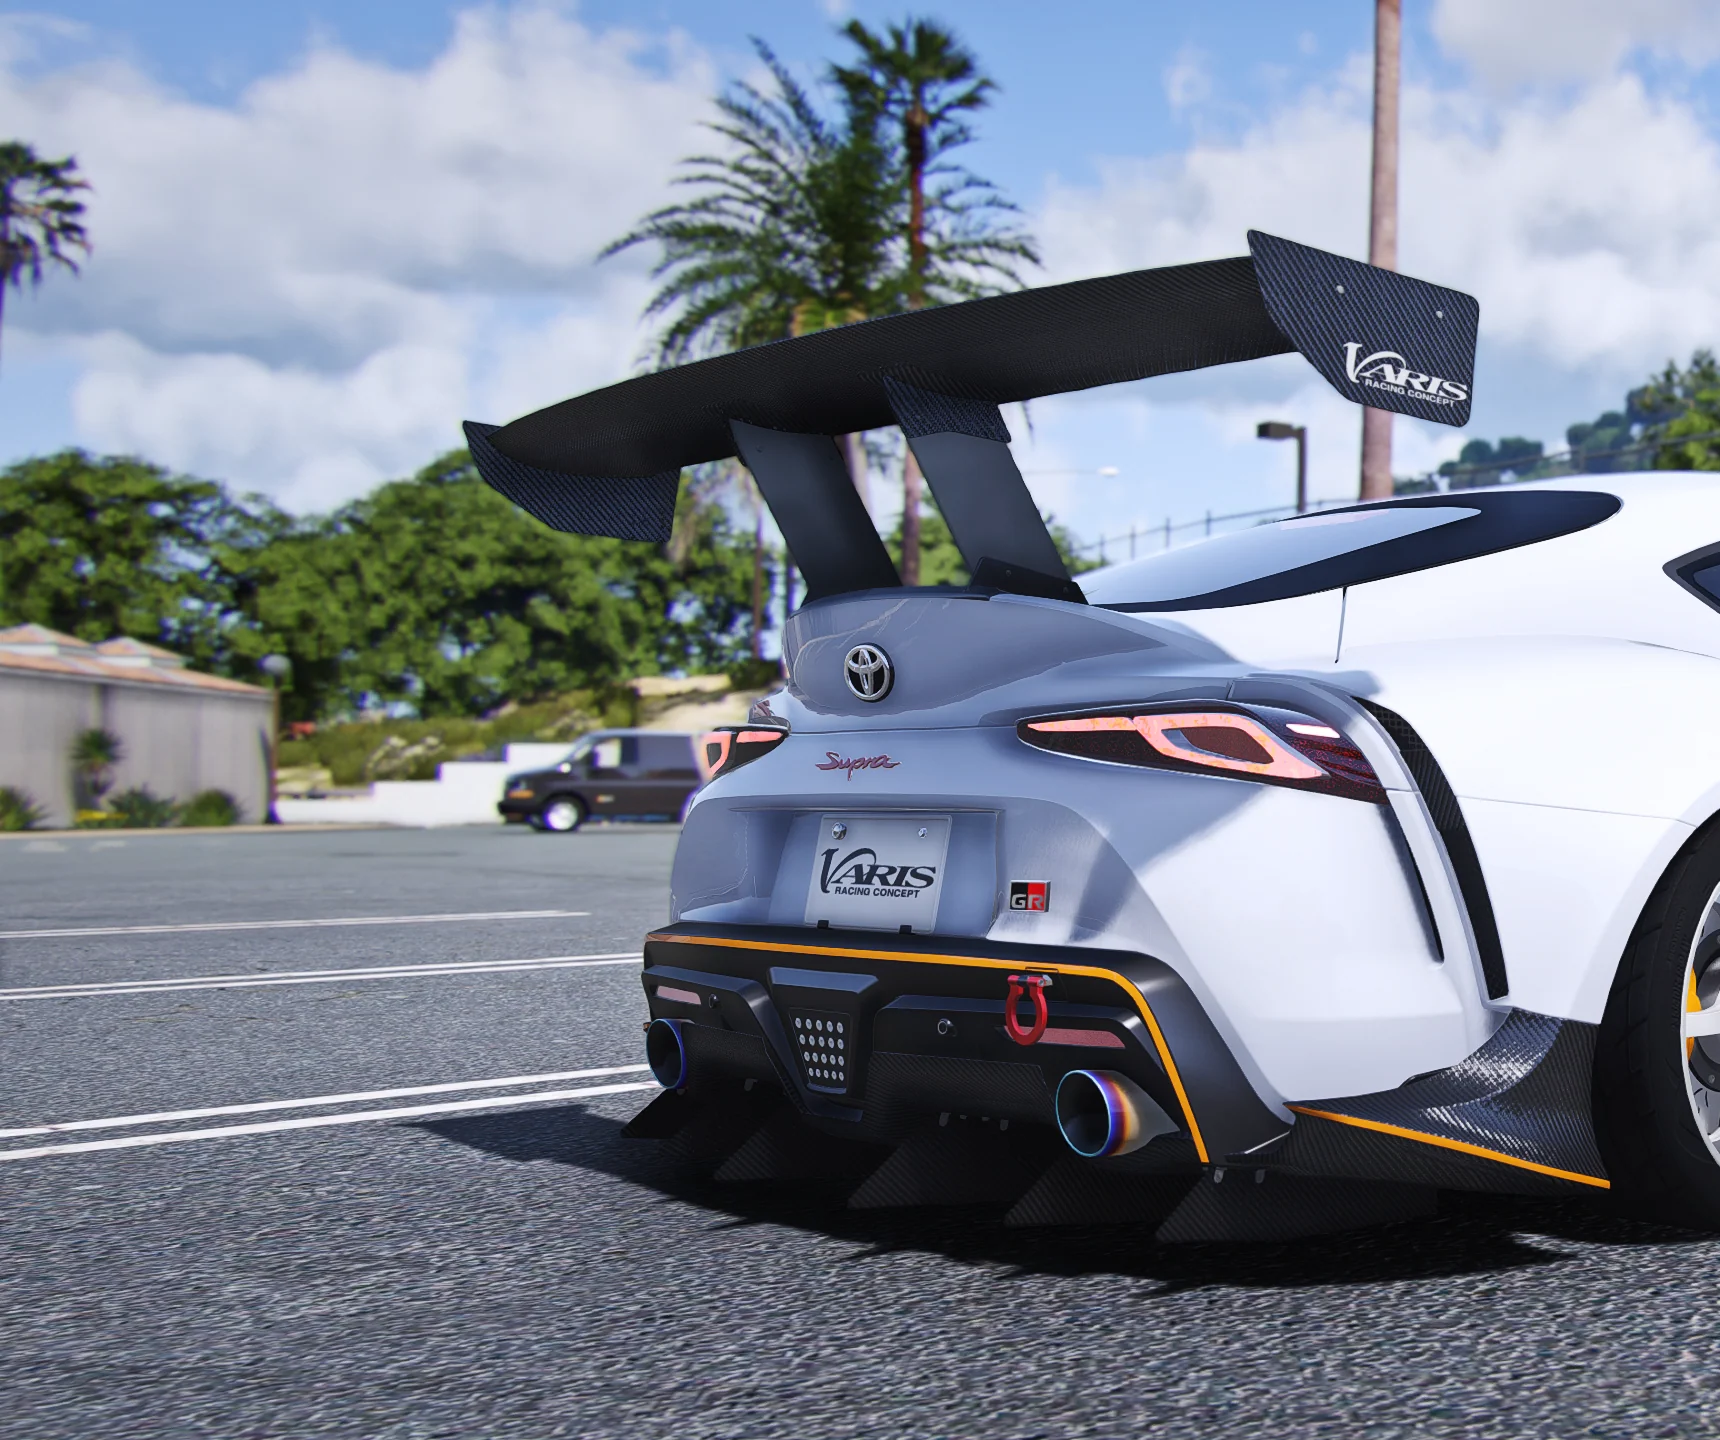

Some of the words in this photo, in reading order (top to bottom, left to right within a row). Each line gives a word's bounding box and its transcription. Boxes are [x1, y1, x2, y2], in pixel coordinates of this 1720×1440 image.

[1343, 341, 1468, 401] VARIS
[1364, 378, 1405, 396] RACING
[1407, 389, 1455, 408] CONCEPT
[815, 751, 901, 781] Supra
[820, 847, 936, 893] VARIS
[834, 886, 870, 897] RACING
[873, 887, 920, 898] CONCEPT
[1011, 893, 1044, 909] GR
